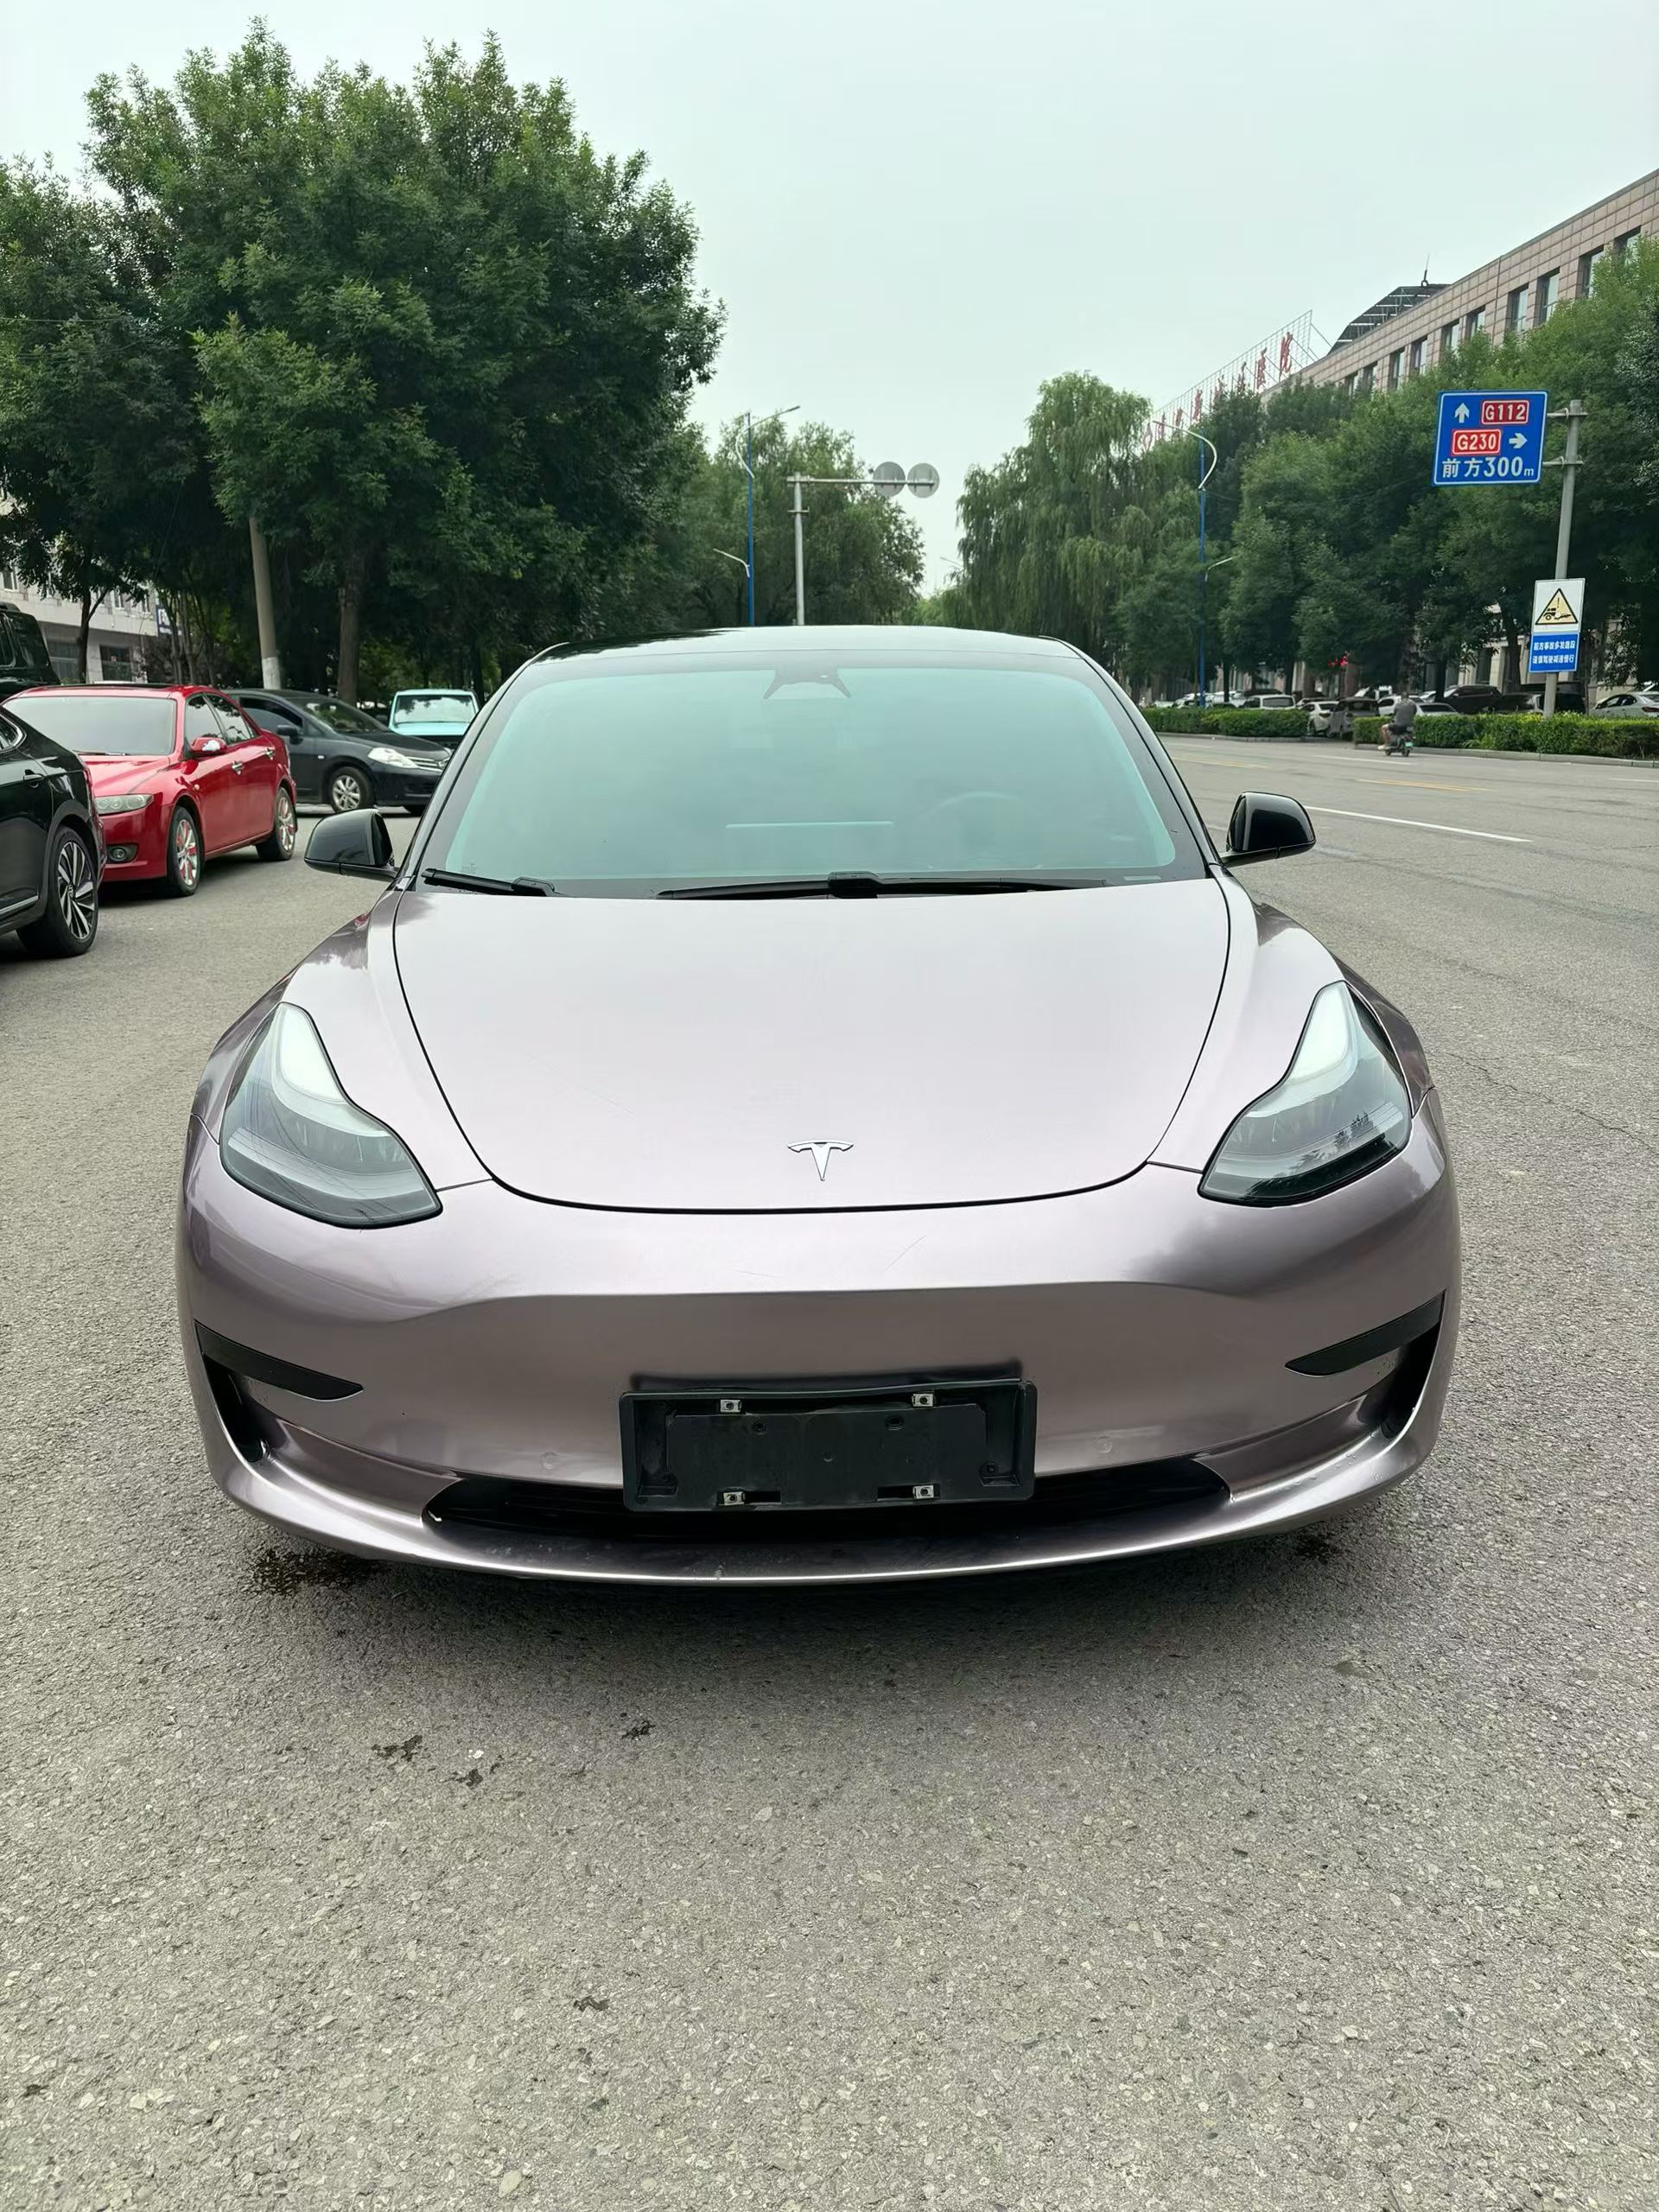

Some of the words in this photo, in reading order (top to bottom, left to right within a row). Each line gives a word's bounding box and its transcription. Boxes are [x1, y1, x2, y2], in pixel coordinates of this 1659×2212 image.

[1485, 404, 1526, 422] G112
[1457, 434, 1497, 451] G230
[1442, 456, 1535, 478] 前方300m
